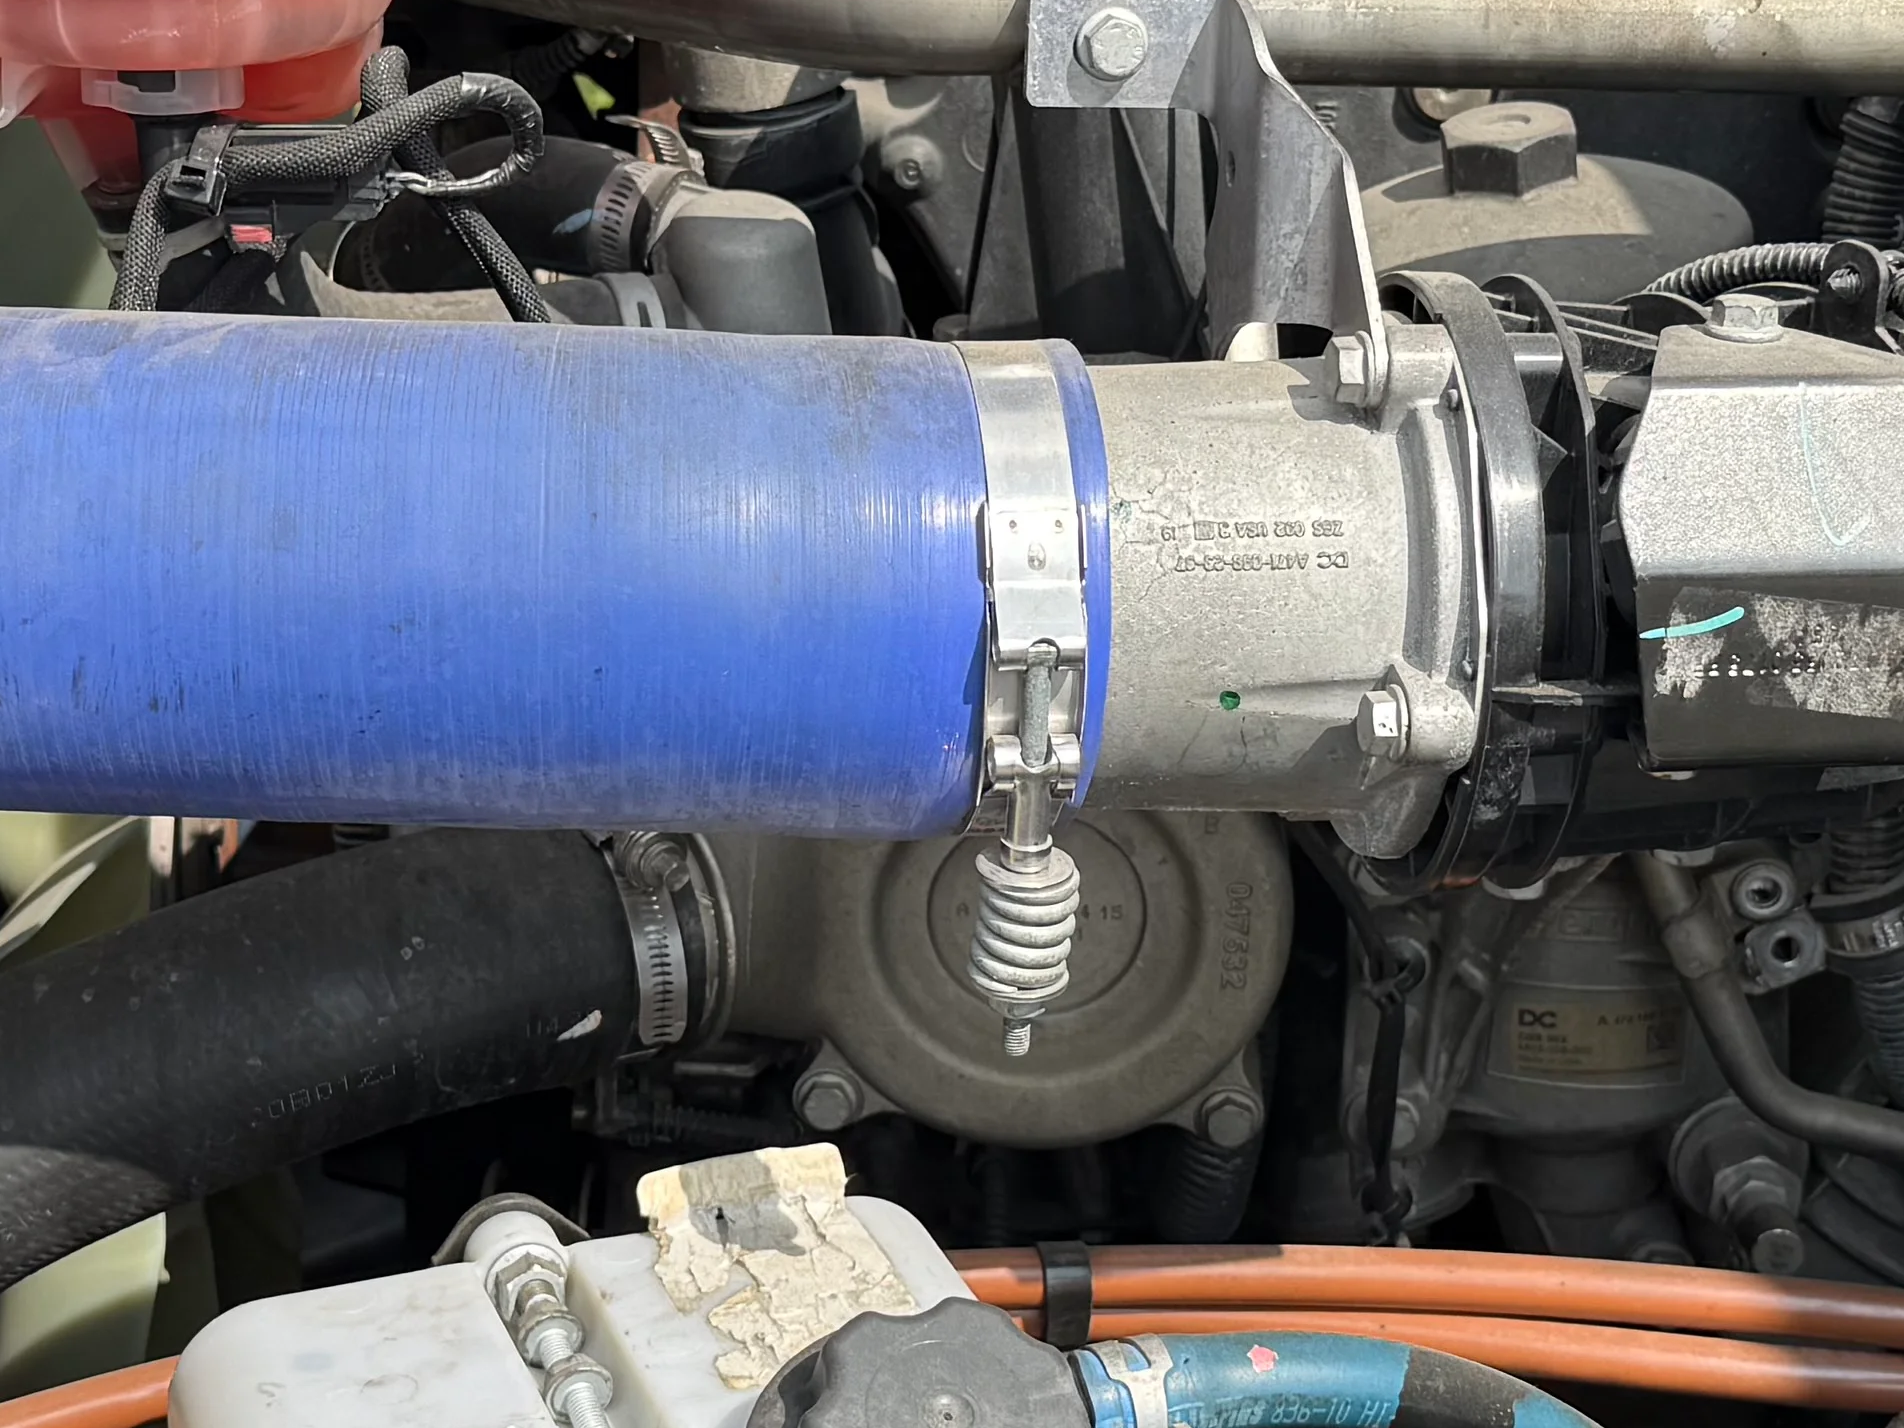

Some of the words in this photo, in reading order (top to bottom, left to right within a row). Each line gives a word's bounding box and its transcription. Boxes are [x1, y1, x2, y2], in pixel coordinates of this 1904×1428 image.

[1234, 521, 1269, 538] USA
[1315, 551, 1349, 569] DC
[1218, 879, 1255, 992] 047532
[1517, 1008, 1558, 1029] DC
